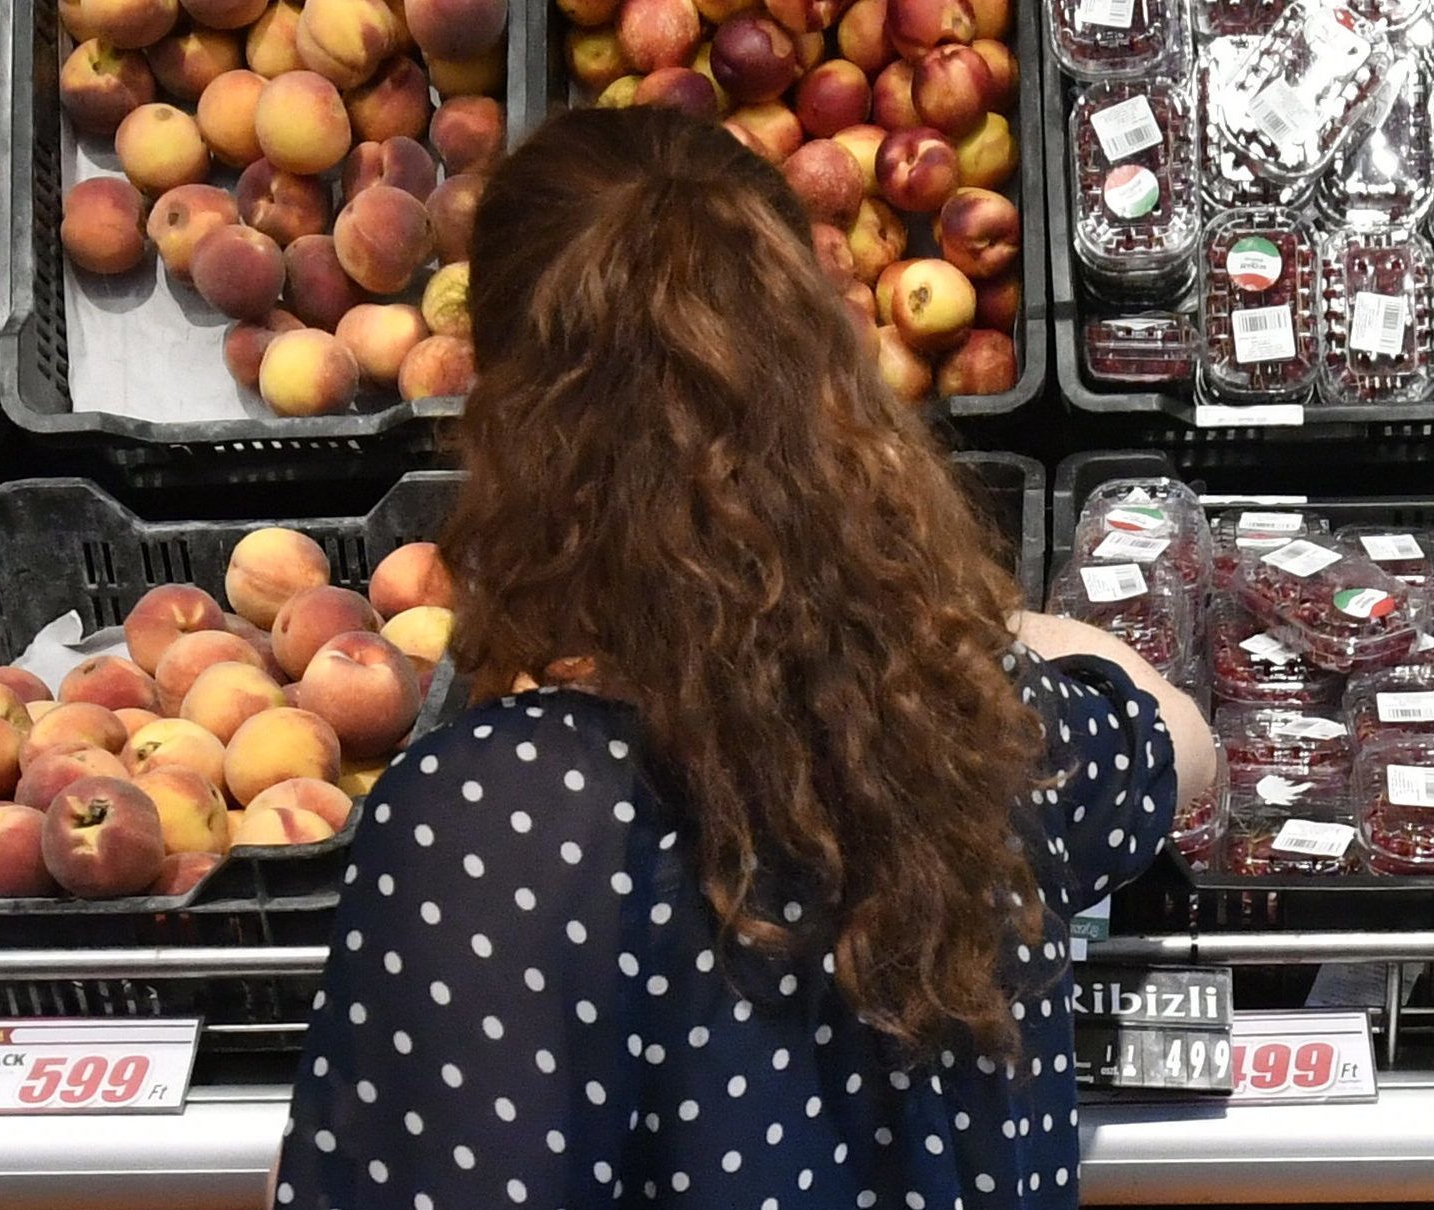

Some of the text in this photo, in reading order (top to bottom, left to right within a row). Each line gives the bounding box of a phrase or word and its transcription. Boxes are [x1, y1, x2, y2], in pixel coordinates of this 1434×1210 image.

[1073, 983, 1218, 1018] Ribizli
[1166, 1039, 1230, 1079] 499
[1341, 1063, 1359, 1078] Ft
[17, 1055, 168, 1104] 599 Ft
